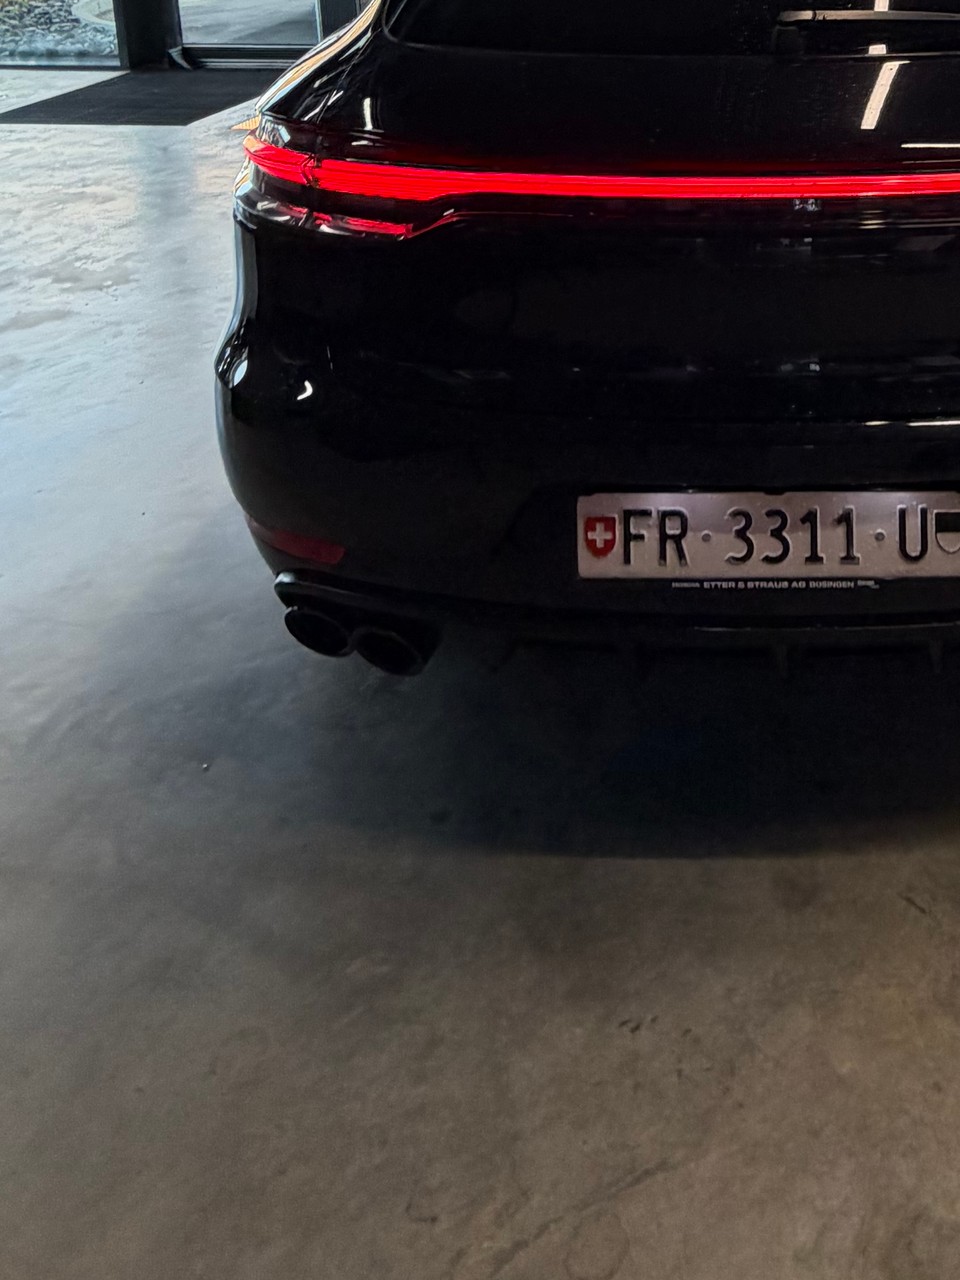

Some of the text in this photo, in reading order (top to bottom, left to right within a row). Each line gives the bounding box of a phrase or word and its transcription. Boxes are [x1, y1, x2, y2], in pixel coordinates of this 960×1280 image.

[622, 506, 929, 566] FR 3311 U
[703, 581, 736, 589] ETTER
[747, 581, 789, 589] STRAUB
[791, 581, 806, 589] AG
